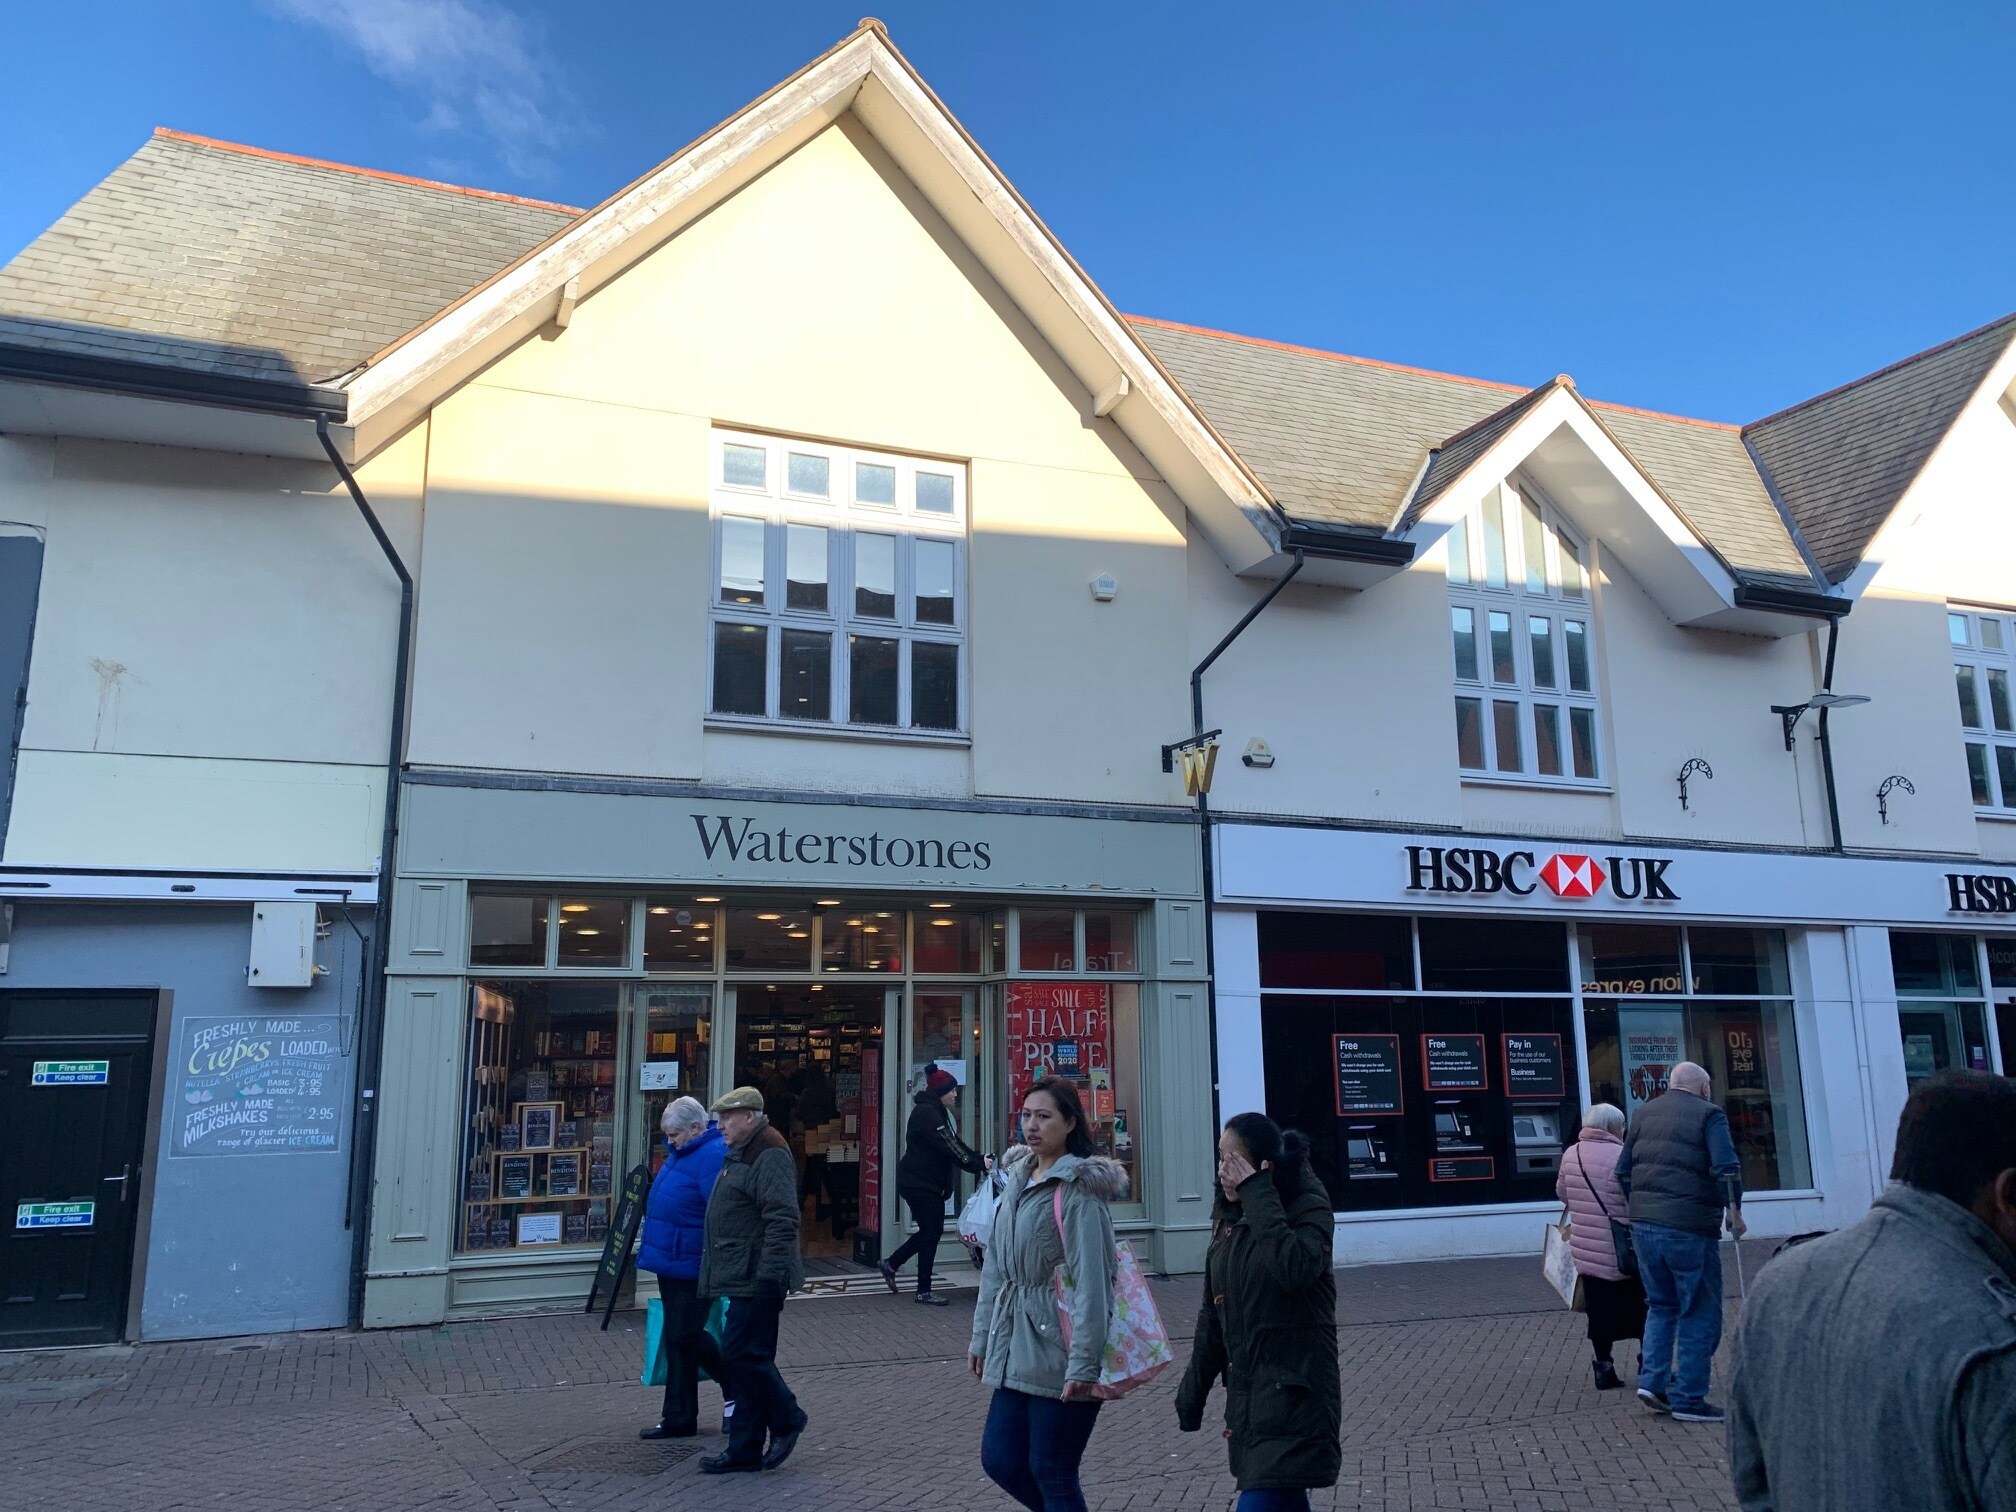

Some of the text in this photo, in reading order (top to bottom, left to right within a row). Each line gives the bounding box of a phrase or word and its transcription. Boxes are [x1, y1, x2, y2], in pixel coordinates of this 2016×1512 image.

[1178, 743, 1220, 796] W
[690, 814, 991, 870] Waterstones
[1404, 846, 1681, 900] HSBC UK
[1945, 873, 2016, 912] HSB
[1051, 989, 1082, 1008] SALE
[193, 1021, 258, 1048] FRESHLY
[1026, 1008, 1100, 1038] HALF
[280, 1041, 328, 1056] LOADED
[1340, 1040, 1358, 1050] Free
[1428, 1039, 1446, 1048] Free
[1509, 1040, 1531, 1050] Pay in
[244, 1070, 270, 1084] CREAM
[296, 1070, 323, 1079] CREAM
[282, 1058, 306, 1068] FRESH
[308, 1062, 332, 1072] FRUIT
[186, 1099, 274, 1129] FRESHLY MADE
[183, 1110, 268, 1148] MILKSHAKES
[217, 1135, 335, 1149] range of glacier ICE CREAM
[864, 1146, 878, 1206] SALE
